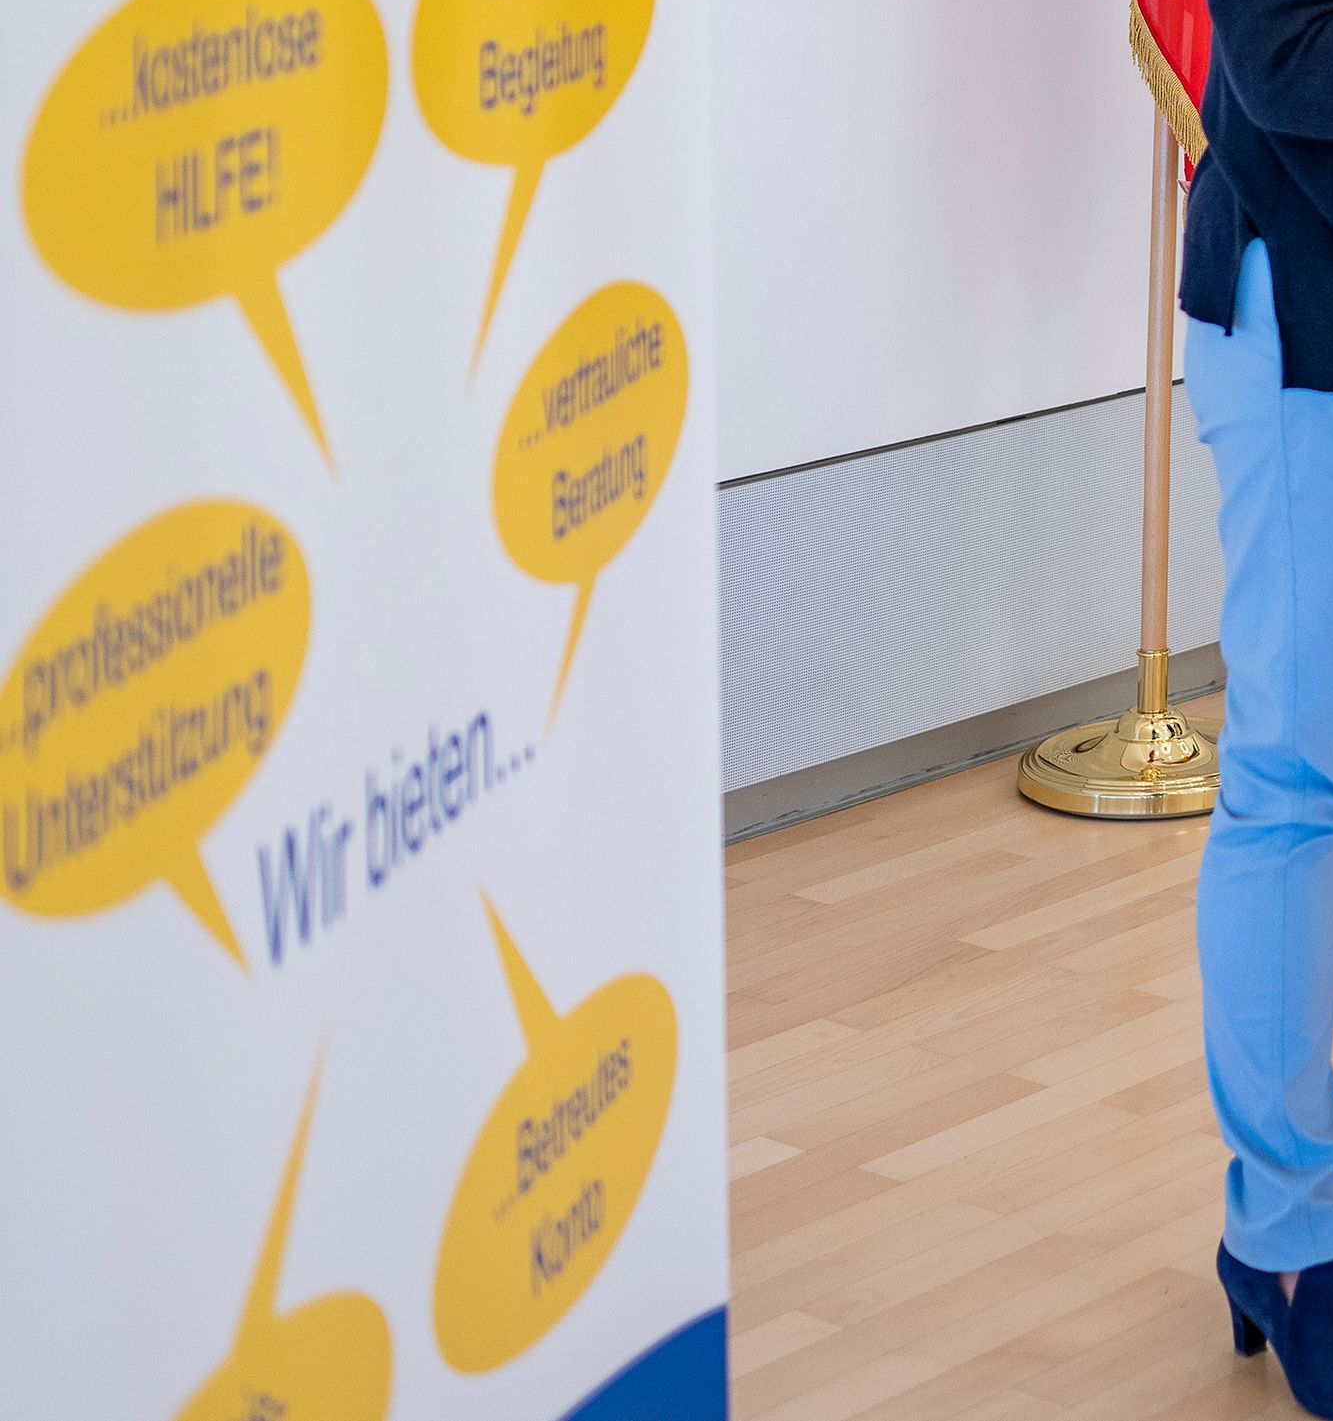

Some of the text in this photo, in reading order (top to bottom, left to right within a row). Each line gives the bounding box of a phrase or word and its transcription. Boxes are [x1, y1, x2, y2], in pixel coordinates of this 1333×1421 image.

[479, 20, 608, 117] Begleitung
[154, 124, 281, 248] HILFE!
[551, 433, 647, 542] Beratung
[2, 668, 274, 896] Unterstützung
[256, 800, 354, 970] Wir
[529, 1178, 607, 1298] Konto
